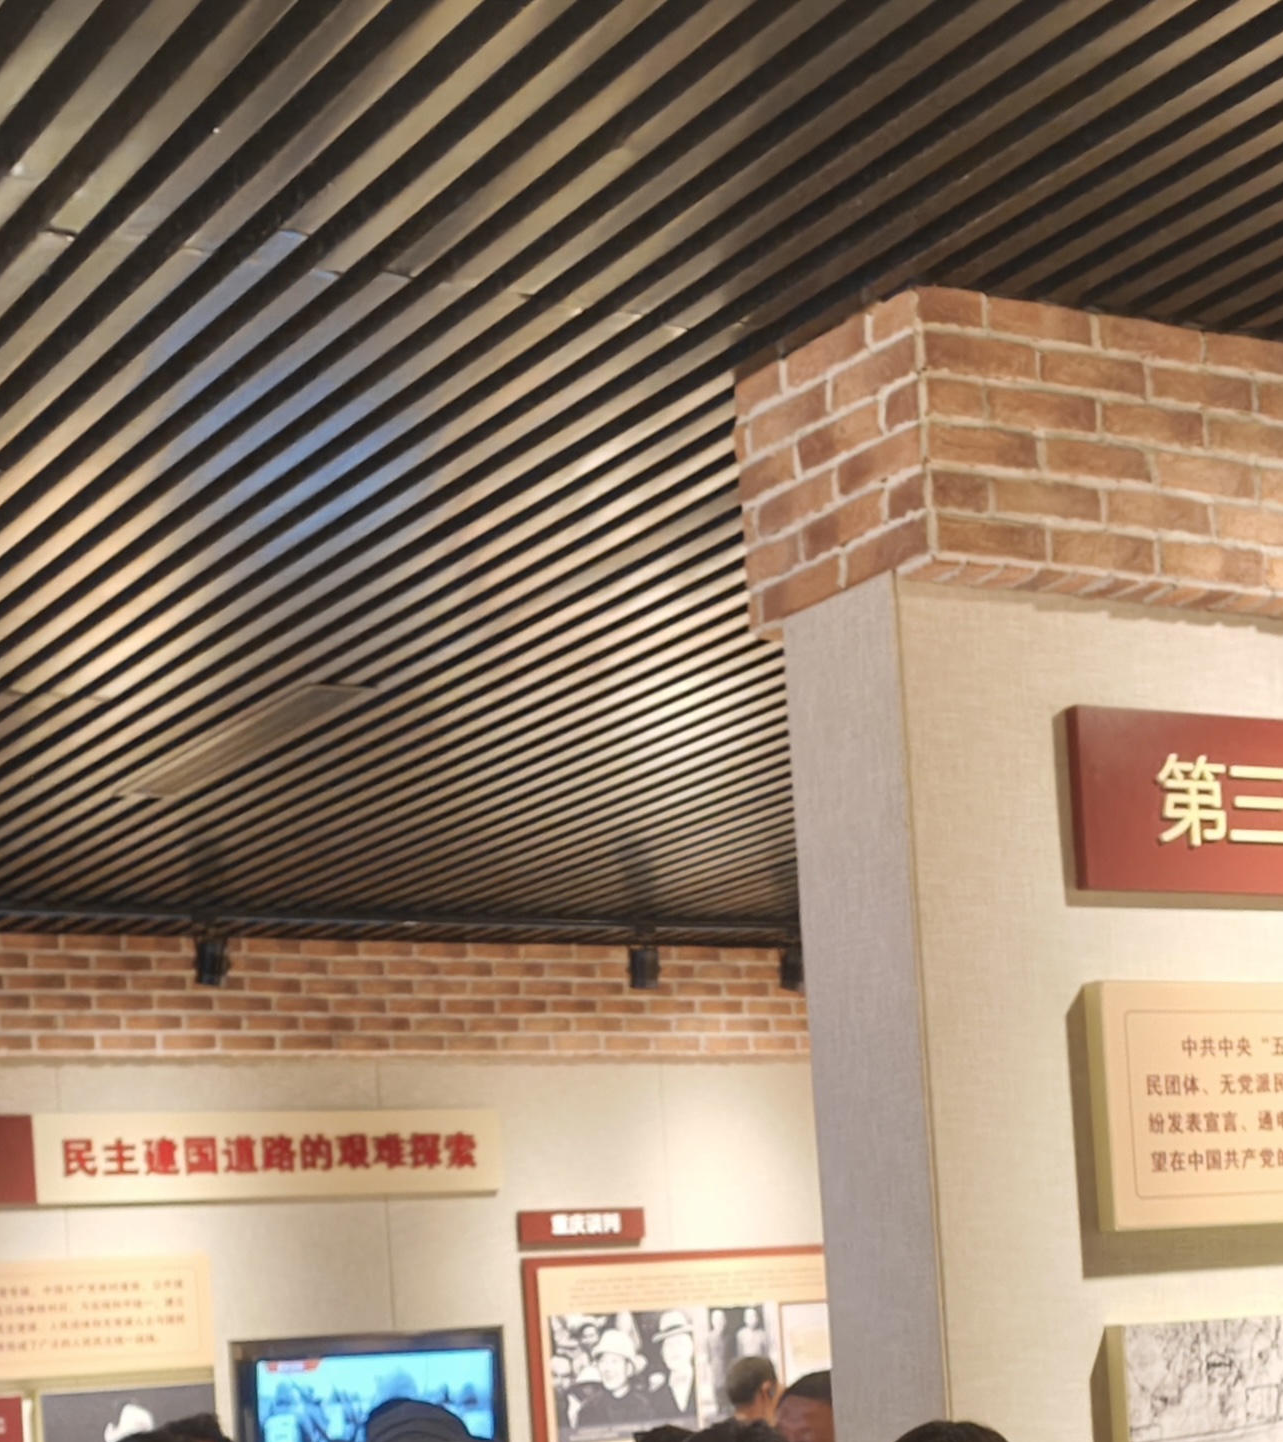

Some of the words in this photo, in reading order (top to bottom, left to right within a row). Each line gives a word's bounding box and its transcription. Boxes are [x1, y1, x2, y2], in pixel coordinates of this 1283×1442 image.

[62, 1132, 478, 1178] 民主建国道路的艰难探索
